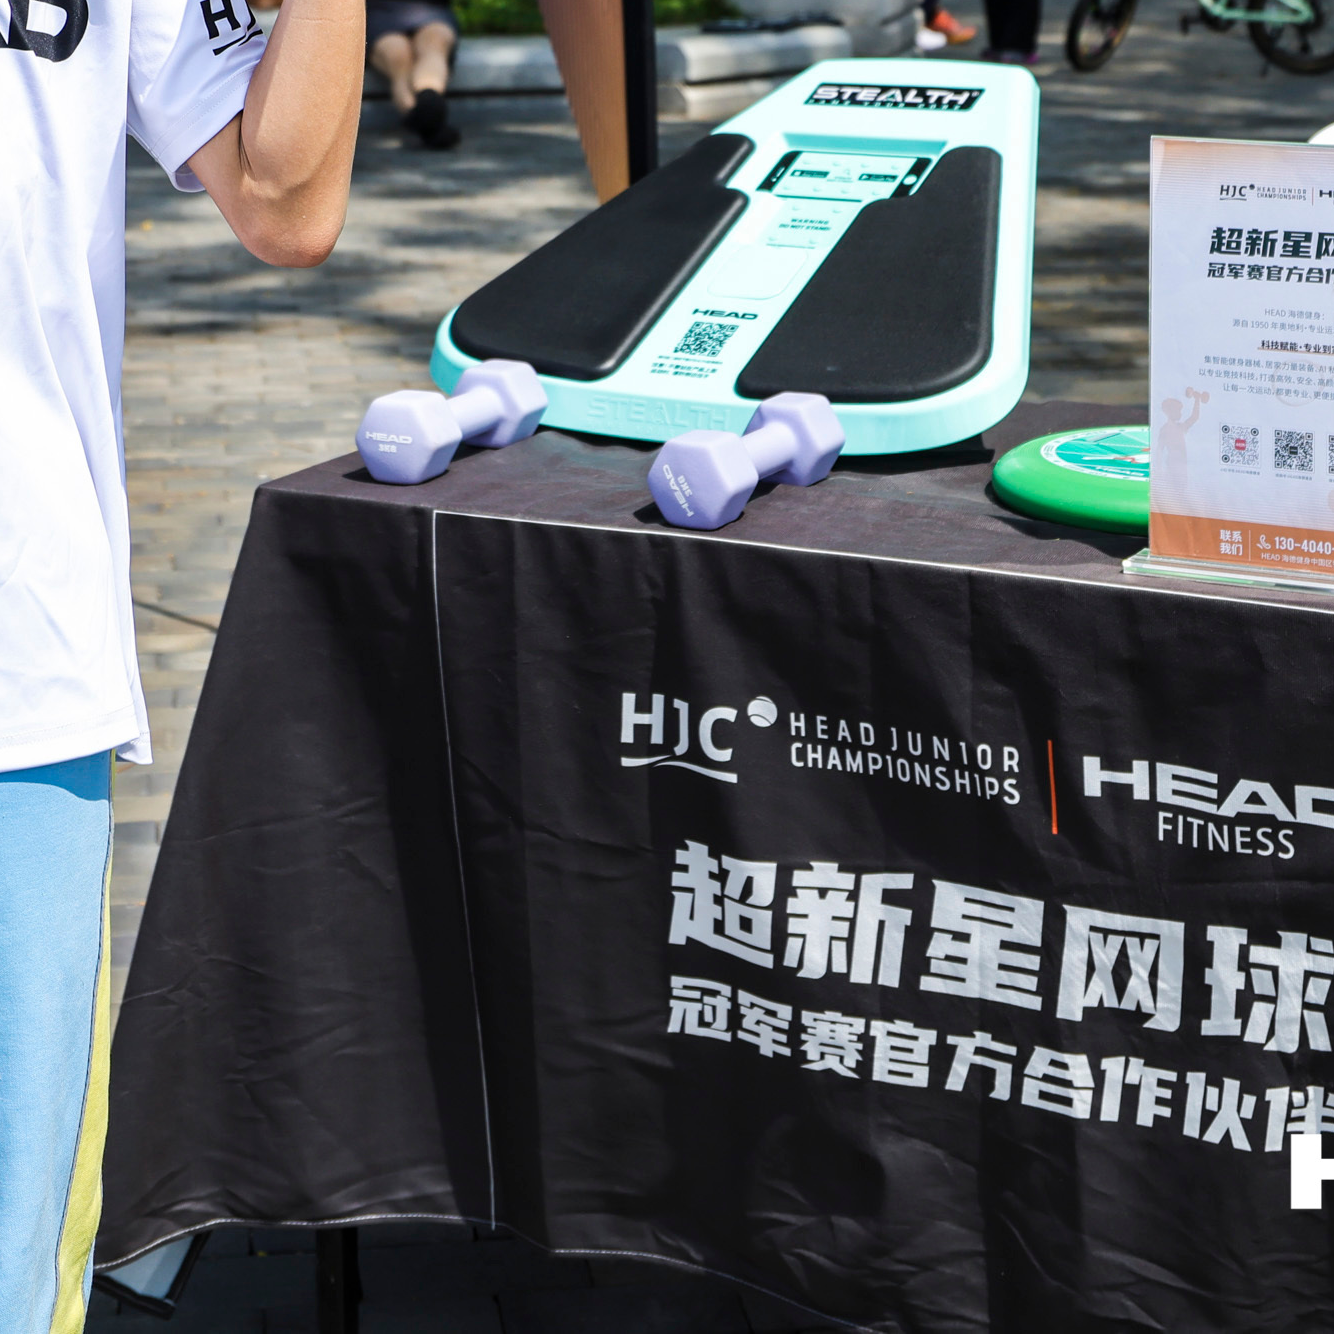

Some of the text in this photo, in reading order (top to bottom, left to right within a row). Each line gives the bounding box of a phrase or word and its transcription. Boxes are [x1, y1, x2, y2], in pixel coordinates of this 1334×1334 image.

[1220, 184, 1247, 198] HJC
[692, 308, 758, 320] HEAD
[1264, 309, 1286, 317] HEAD
[1232, 318, 1249, 328] 源自
[1251, 320, 1269, 329] 1950
[365, 431, 412, 444] HEAD
[378, 444, 398, 453] 3KG
[662, 464, 695, 517] HEAD
[1220, 529, 1242, 542] 联系
[1220, 543, 1243, 556] 我们
[1261, 553, 1280, 561] HEAD
[620, 693, 738, 762] HJC
[790, 711, 1020, 773] HEAD JUNIOR
[791, 741, 1021, 806] CHAMPIONSHIPS
[1157, 811, 1296, 861] FITNESS
[668, 839, 1334, 1054] 超新星网球
